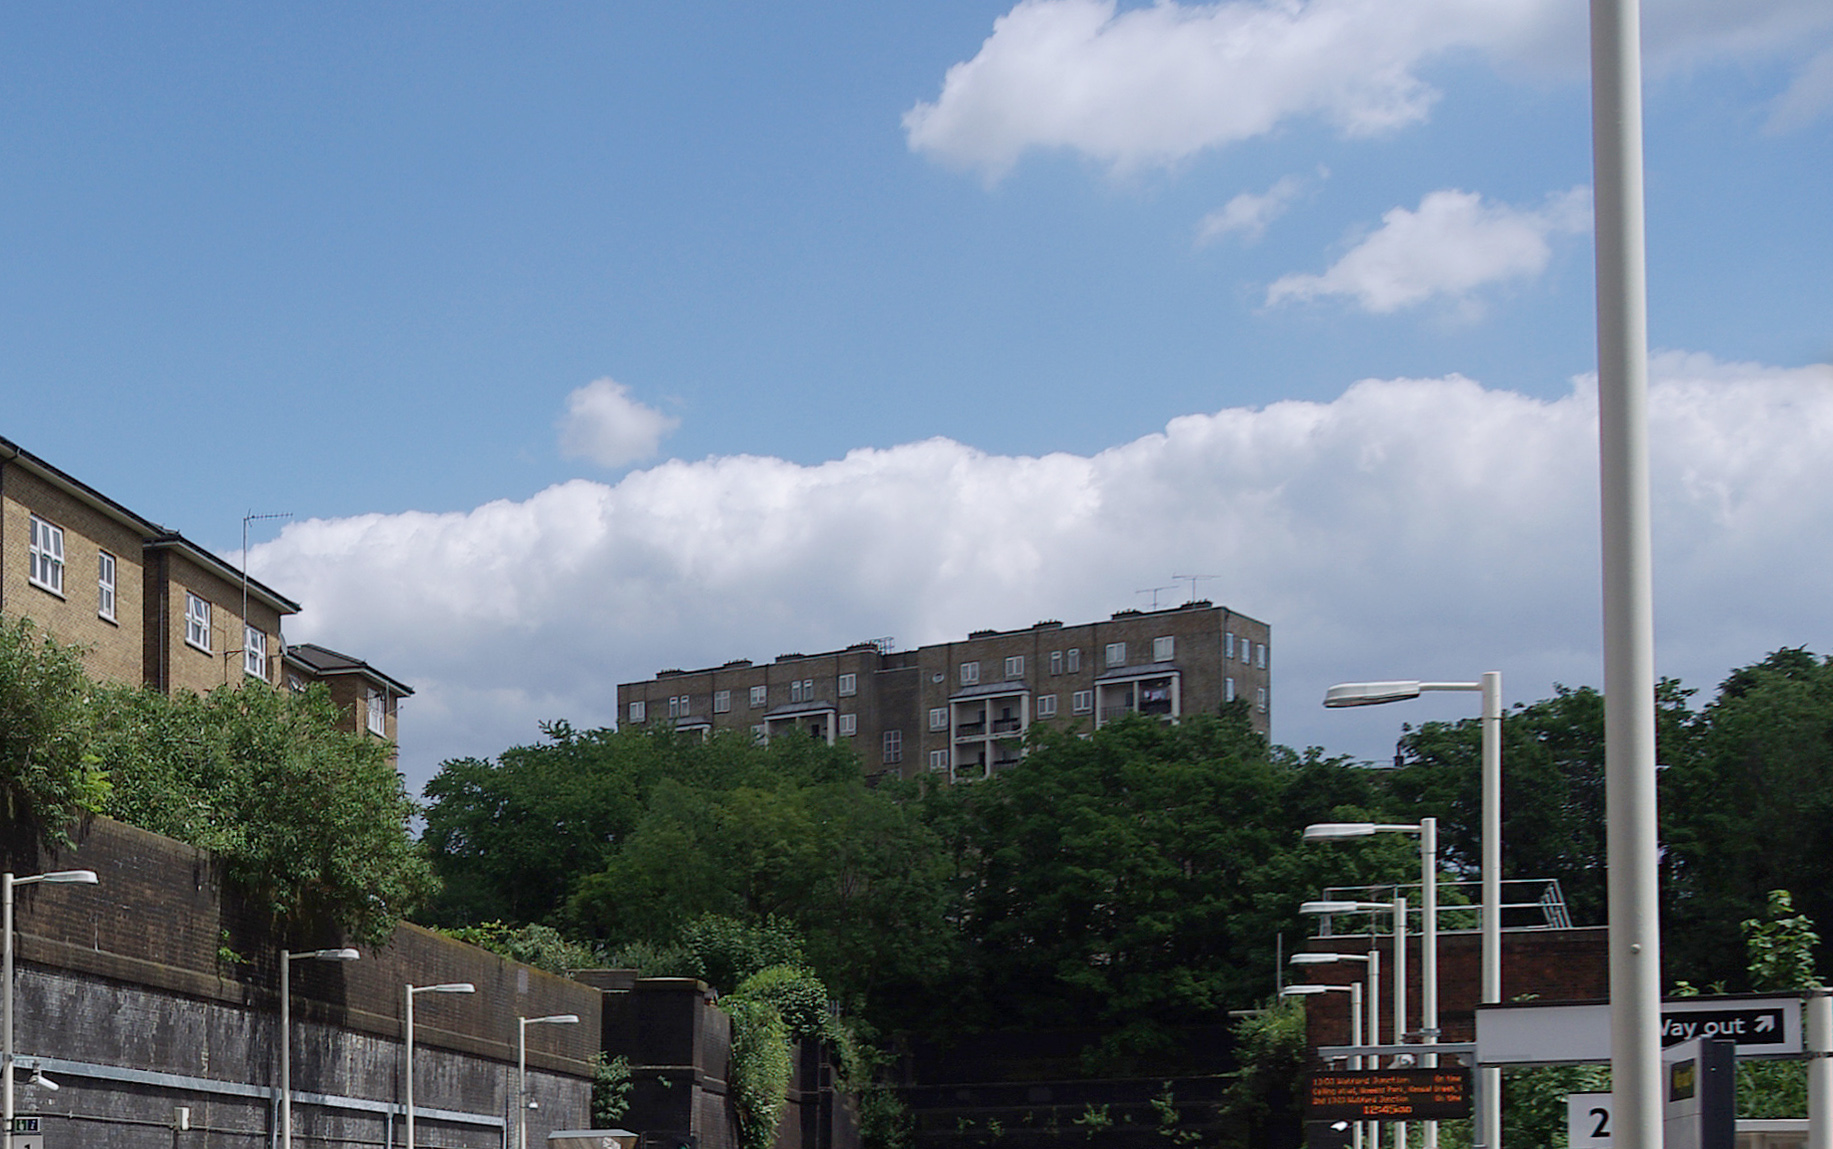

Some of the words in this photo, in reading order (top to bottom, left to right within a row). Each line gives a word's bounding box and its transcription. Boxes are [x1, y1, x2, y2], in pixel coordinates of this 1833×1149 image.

[1704, 1017, 1746, 1035] out
[1372, 1076, 1411, 1085] Junction
[1378, 1095, 1410, 1103] Junction
[1589, 1107, 1611, 1138] 2
